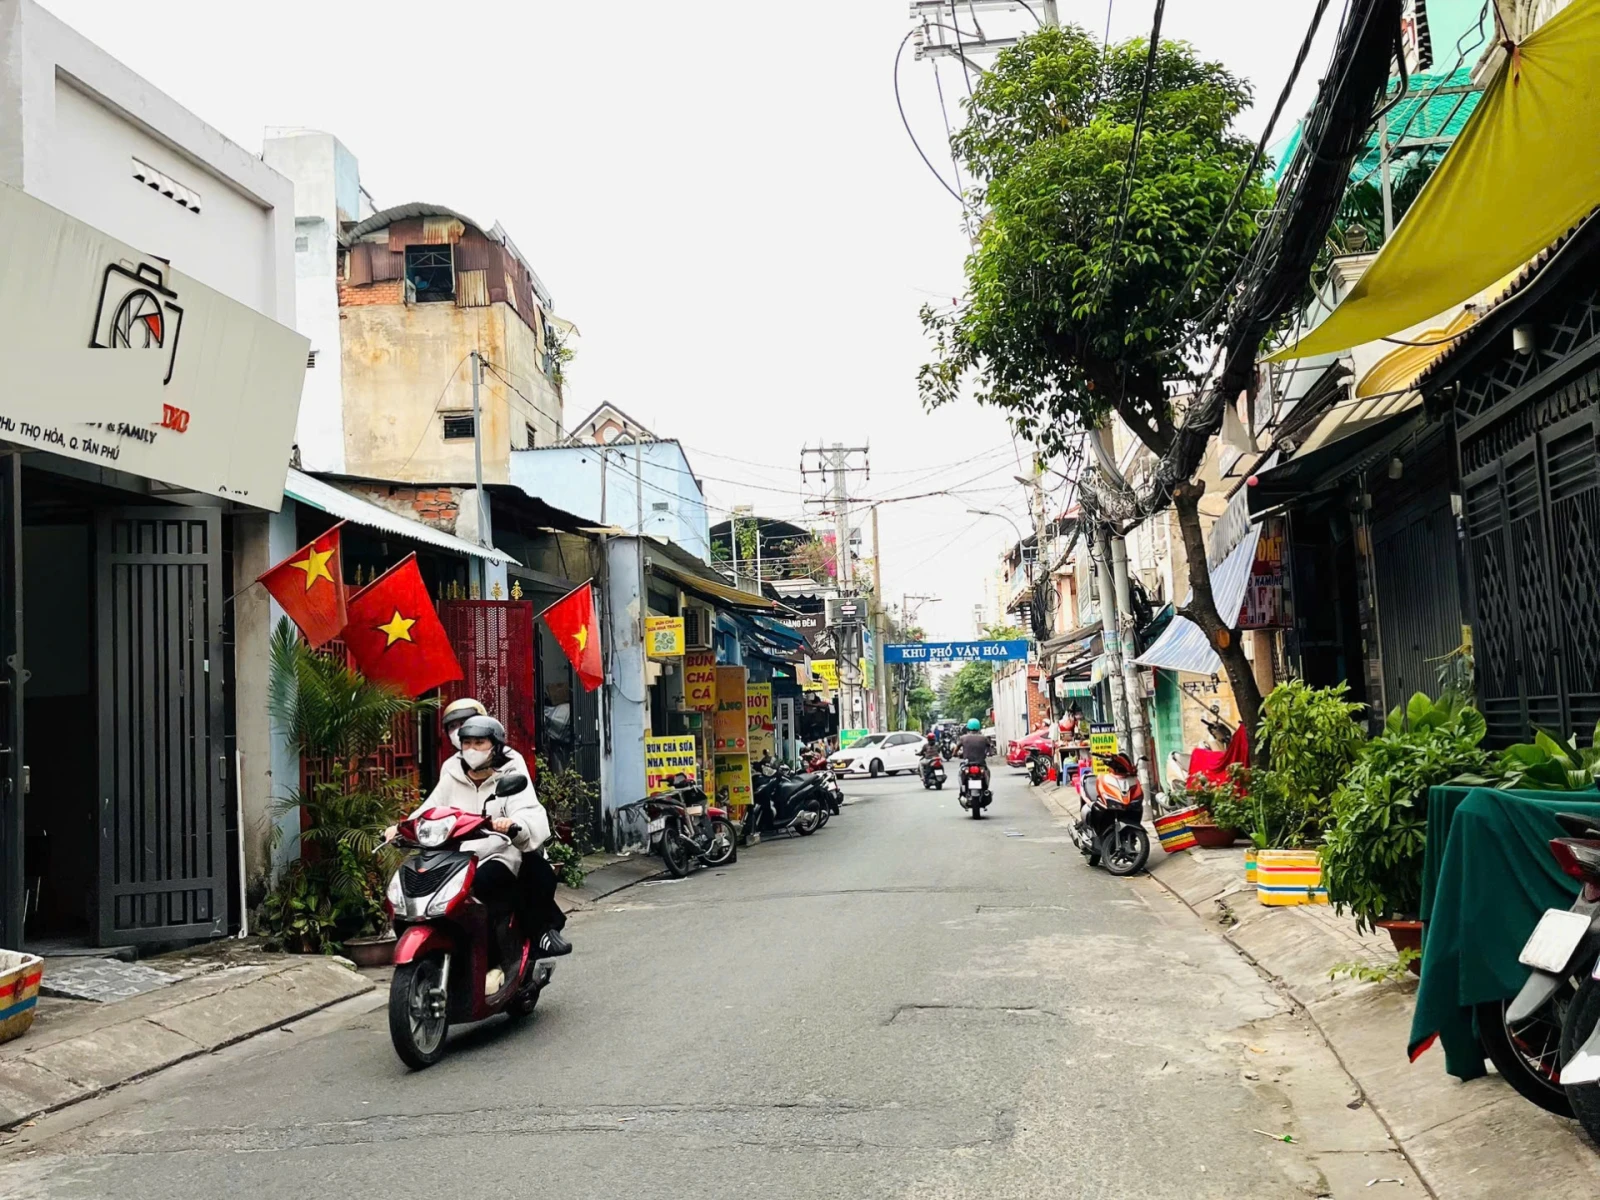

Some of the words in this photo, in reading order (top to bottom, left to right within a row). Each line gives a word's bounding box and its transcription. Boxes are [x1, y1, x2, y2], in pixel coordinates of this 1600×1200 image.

[117, 422, 158, 444] FAMILY
[20, 422, 41, 441] THỌ
[82, 438, 100, 456] TÂN
[100, 444, 120, 461] PHÚ
[902, 648, 926, 658] KHU
[929, 643, 952, 658] PHỐ
[955, 645, 980, 657] VĂN
[983, 643, 1008, 656] HÓA
[686, 668, 714, 683] CHẢ
[647, 758, 664, 767] NHA
[666, 756, 694, 767] TRANG
